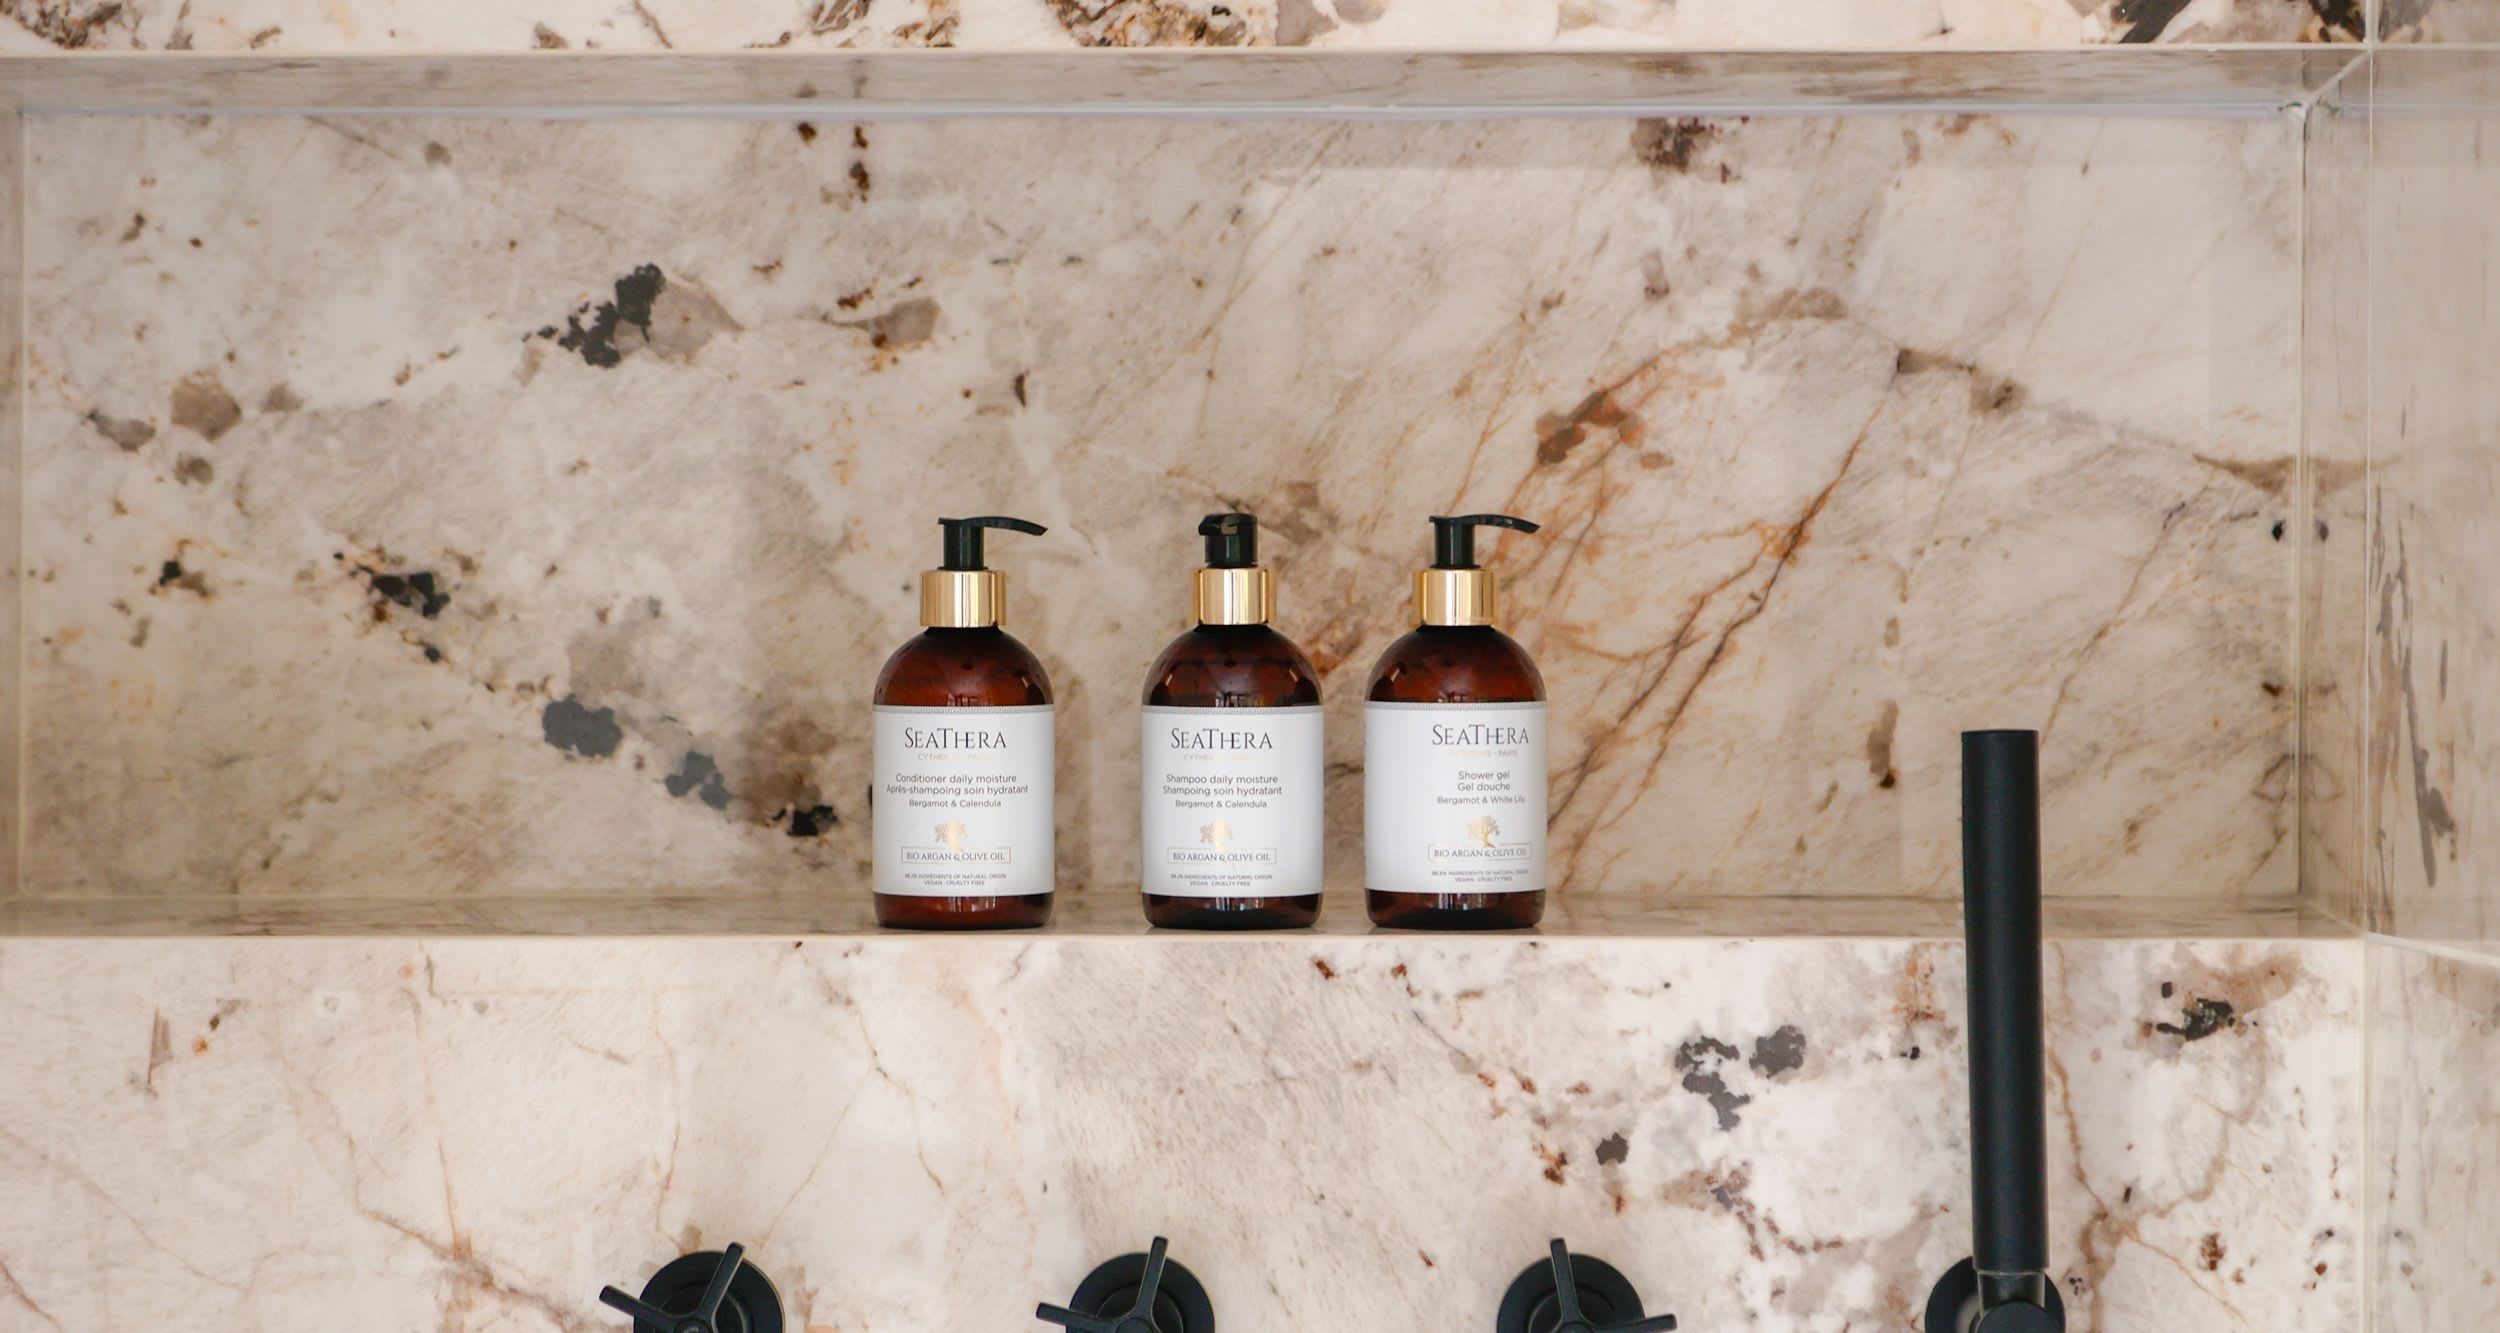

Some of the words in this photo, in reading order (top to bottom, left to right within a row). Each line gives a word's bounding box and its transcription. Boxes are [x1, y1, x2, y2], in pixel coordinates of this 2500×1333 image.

[896, 773, 946, 784] Conditioner
[950, 773, 974, 785] daily
[976, 774, 1017, 784] moisture
[1166, 774, 1207, 785] Shampoo
[1209, 774, 1234, 785] daily
[1236, 775, 1279, 784] moisture
[1458, 770, 1494, 780] Shower
[1497, 770, 1510, 781] gel
[886, 784, 961, 796] Après-shampoing
[964, 786, 985, 795] soin
[987, 785, 1029, 796] hydratant
[1163, 786, 1211, 796] Shampoing
[1213, 786, 1234, 795] soin
[1237, 786, 1282, 796] hydratant
[1457, 782, 1474, 791] Gel
[1477, 782, 1511, 791] douche
[909, 800, 948, 809] Bergamot
[951, 800, 957, 808] &
[959, 800, 1001, 808] Calendula
[1175, 800, 1214, 809] Bergamot
[1225, 800, 1267, 808] Calendula
[1437, 796, 1480, 805] Bergamot
[1482, 796, 1488, 804] &
[1490, 795, 1513, 804] White
[1514, 795, 1526, 804] Lily
[906, 852, 919, 860] BIO
[921, 852, 952, 860] ARGAN
[962, 852, 989, 860] OLIVE
[990, 852, 1005, 860] OIL
[1173, 853, 1185, 861] BIO
[1187, 853, 1217, 861] ARGAN
[1228, 853, 1253, 861] OLIVE
[1256, 853, 1270, 861] OIL
[1434, 849, 1449, 857] BIO
[1452, 849, 1483, 857] ARGAN
[1492, 848, 1515, 857] OLIVE
[1516, 848, 1527, 856] OIL
